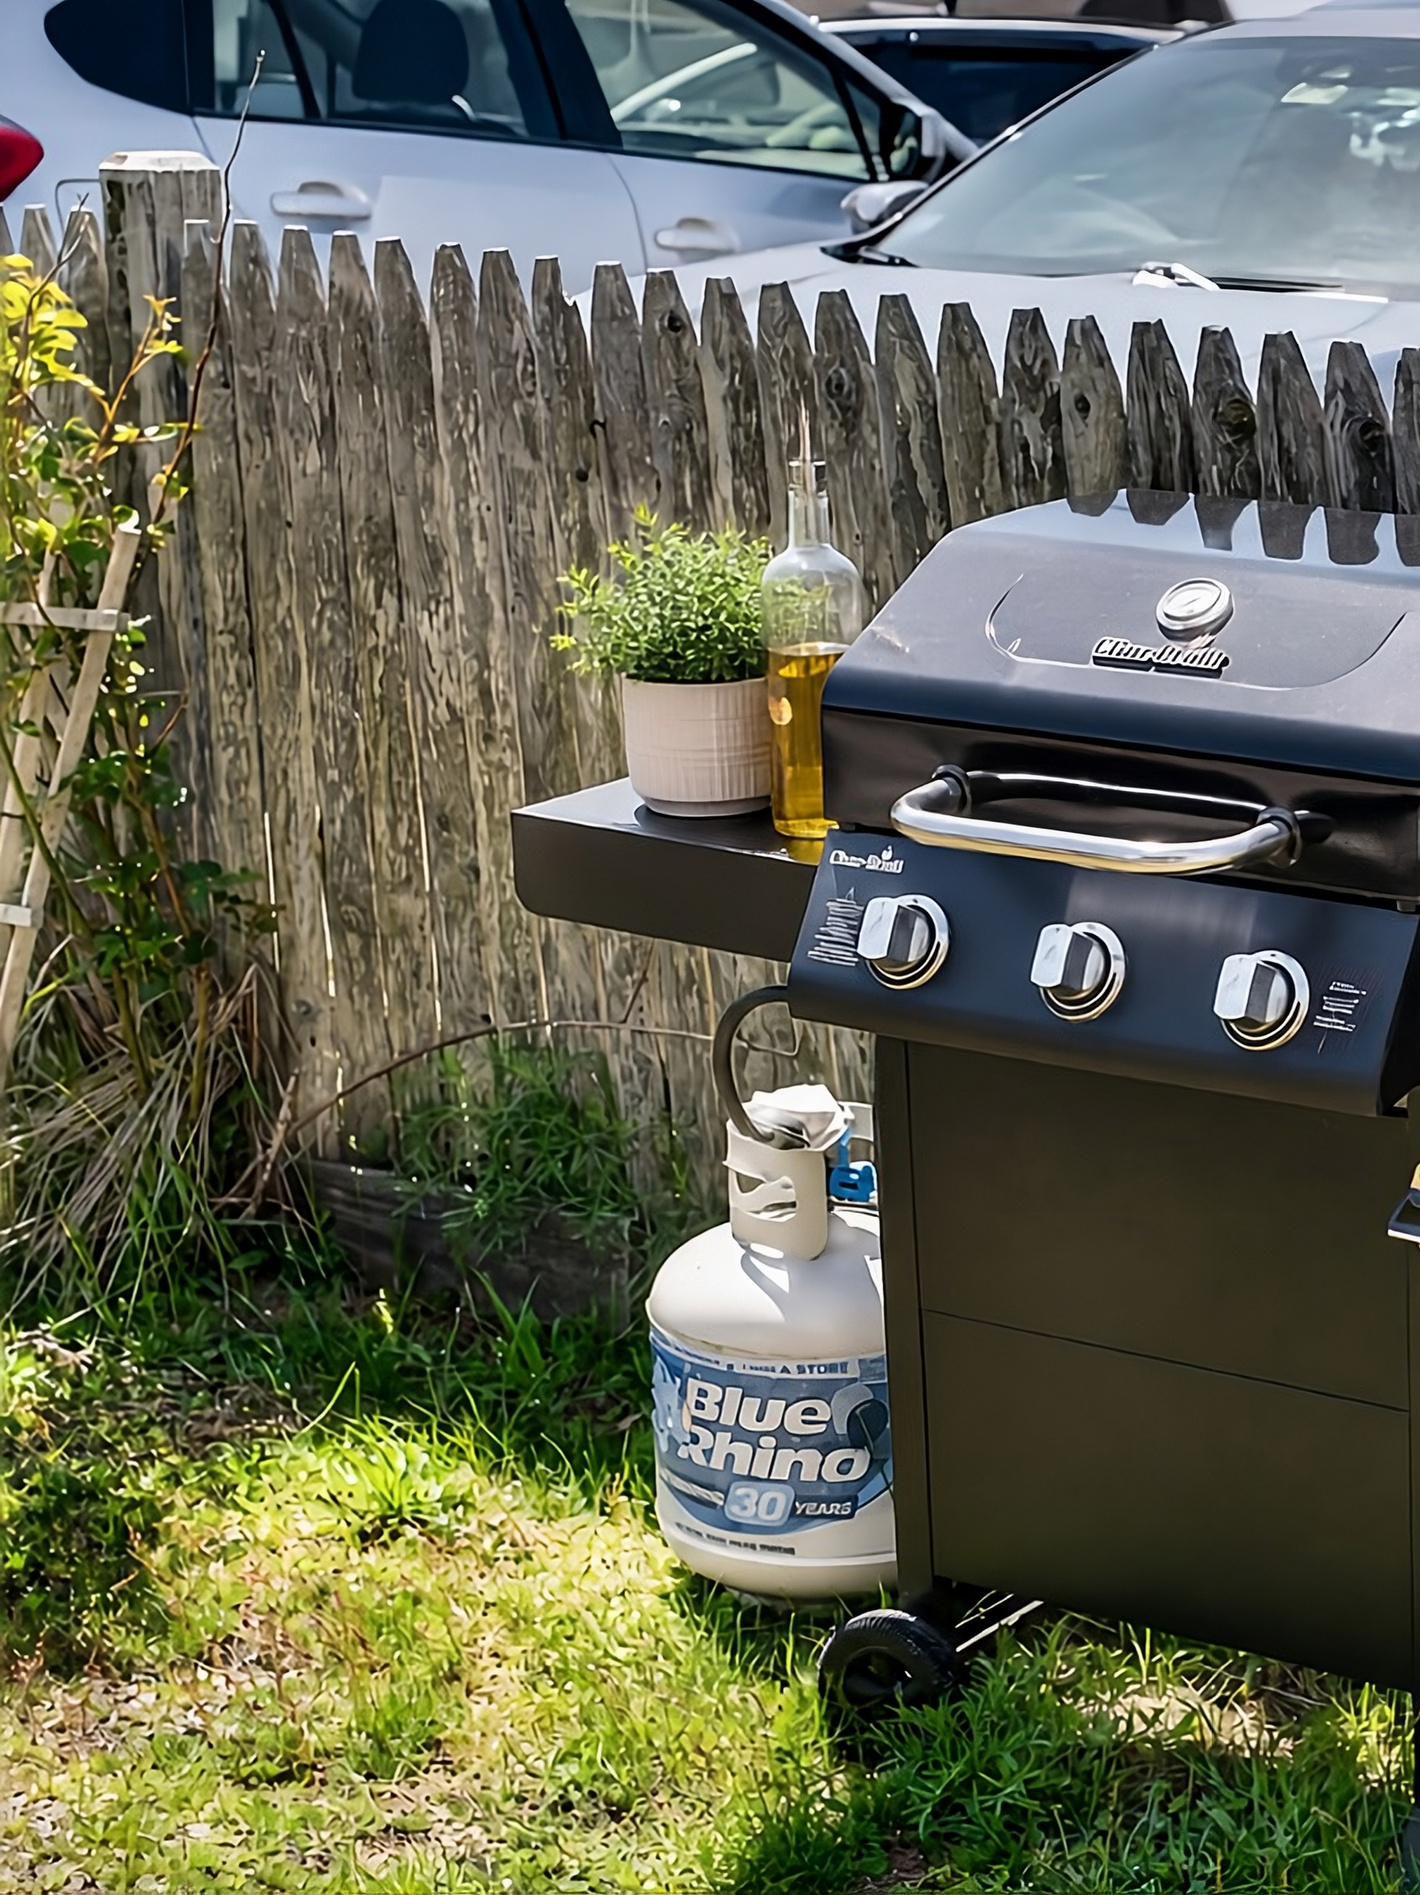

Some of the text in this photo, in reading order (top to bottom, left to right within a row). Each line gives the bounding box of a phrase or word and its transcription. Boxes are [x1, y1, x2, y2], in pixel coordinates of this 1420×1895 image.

[685, 1377, 832, 1435] Blue
[677, 1425, 871, 1483] Rhino
[729, 1486, 787, 1521] 30
[795, 1500, 852, 1516] YEARS
